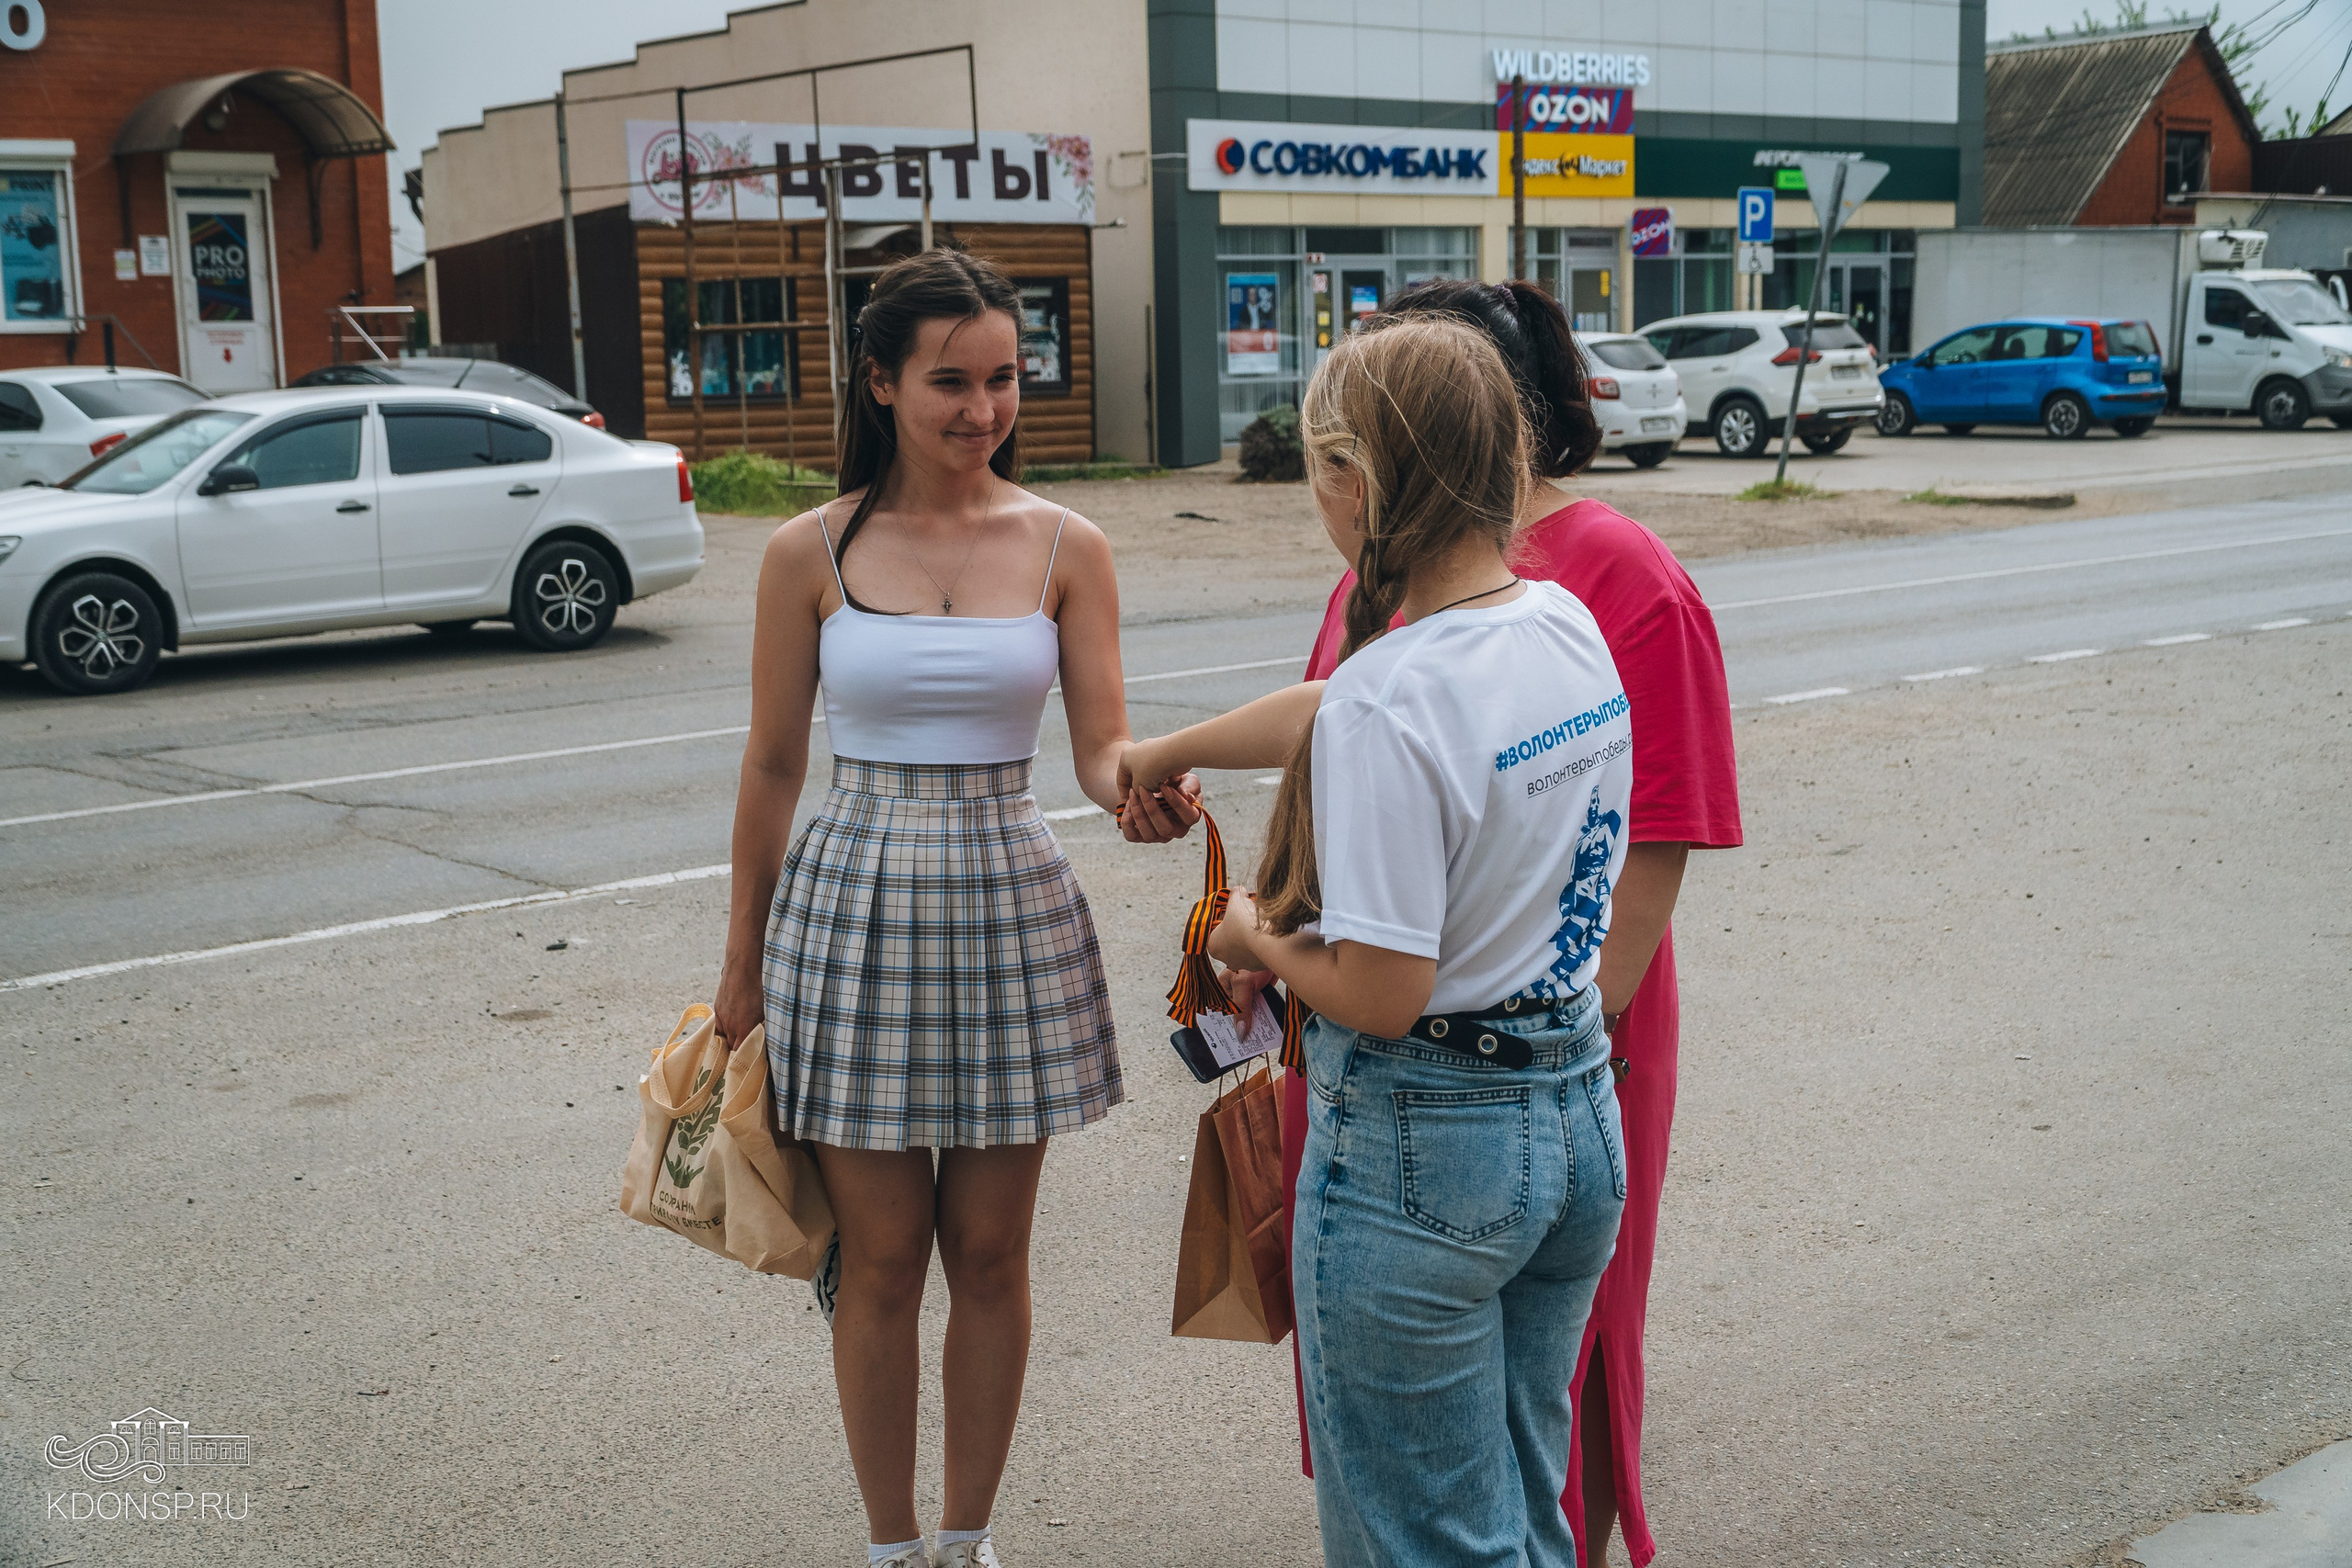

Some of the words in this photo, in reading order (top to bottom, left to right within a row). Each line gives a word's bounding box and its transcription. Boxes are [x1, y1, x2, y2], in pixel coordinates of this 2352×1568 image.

[1493, 48, 1651, 86] WILDBERRIES
[1530, 93, 1610, 124] OZON
[775, 142, 1049, 207] ЦВЕТЫ
[1250, 141, 1487, 178] СОВКОМБАНК
[1512, 156, 1560, 176] ндекс
[1579, 155, 1627, 178] Маркет
[1745, 195, 1766, 238] P
[194, 244, 244, 266] PRO
[197, 267, 245, 279] PHOTO
